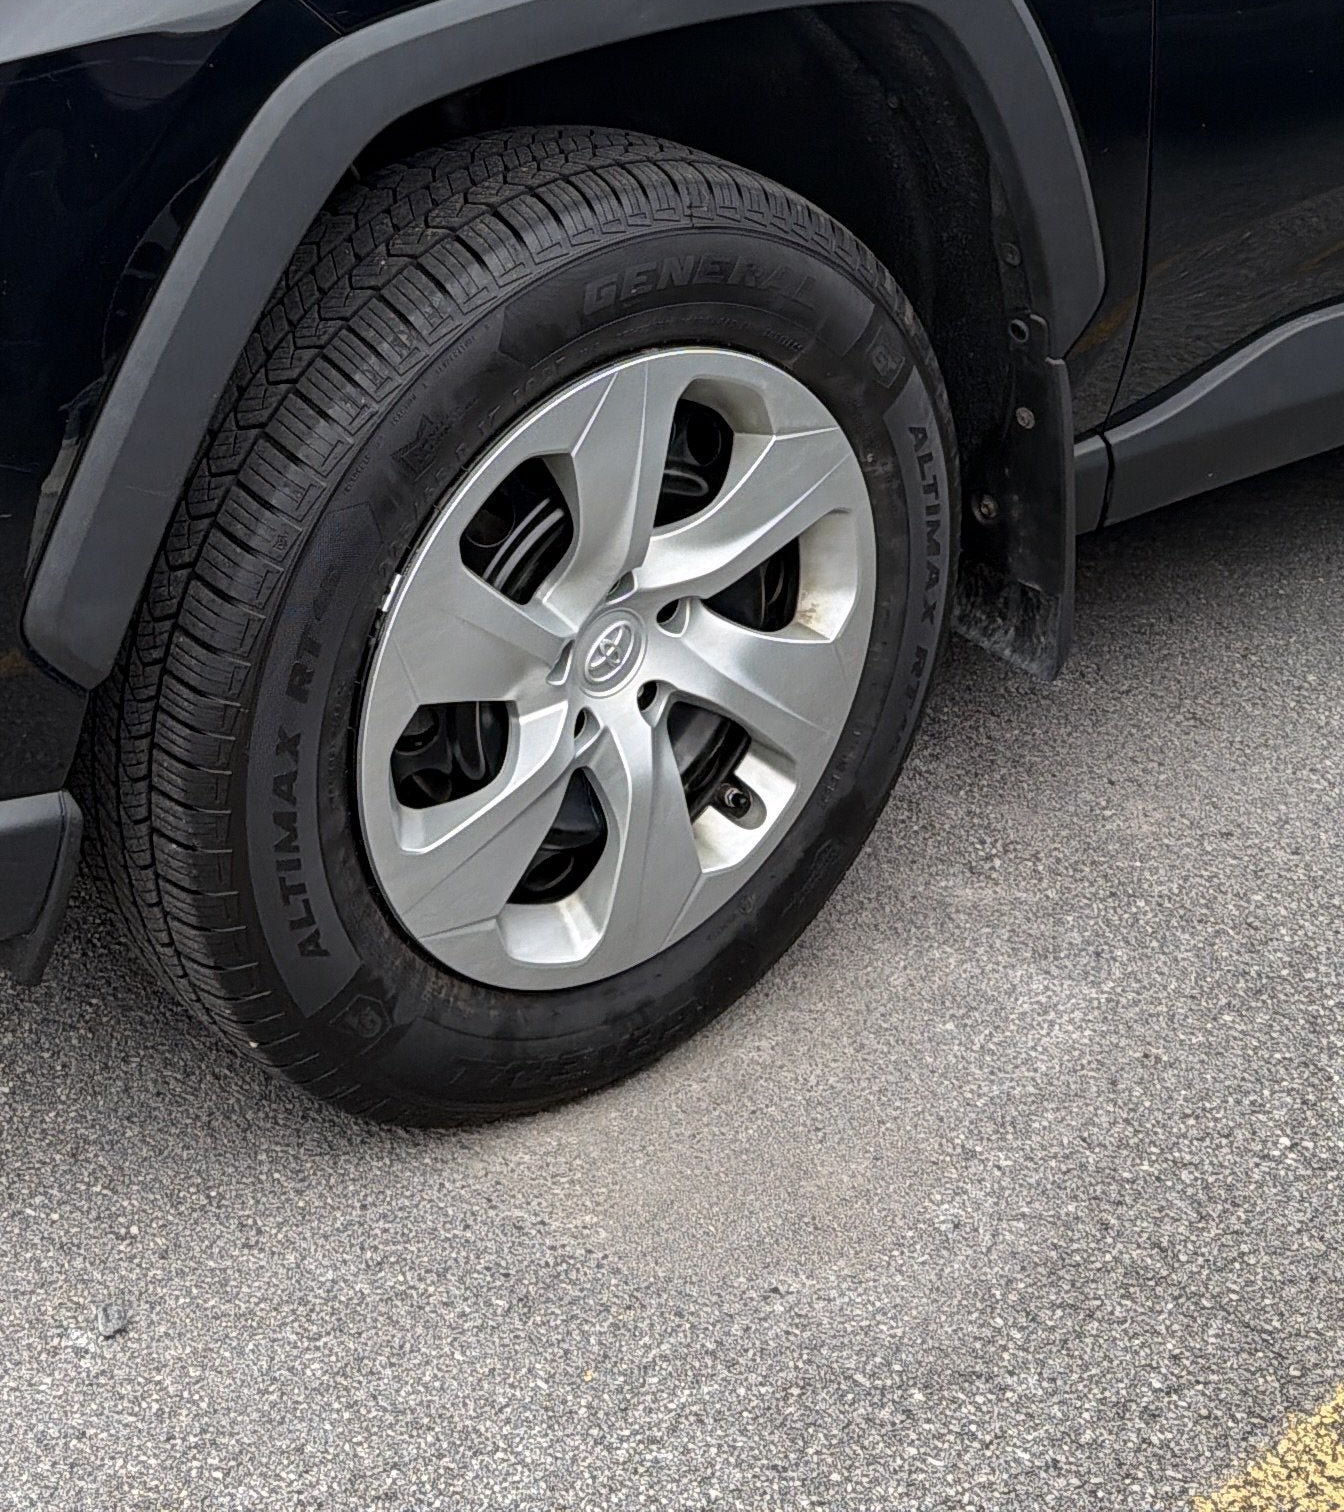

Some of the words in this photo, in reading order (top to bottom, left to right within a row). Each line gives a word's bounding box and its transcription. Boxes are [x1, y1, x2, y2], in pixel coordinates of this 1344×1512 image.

[582, 253, 817, 317] GENERAL
[907, 425, 942, 626] ALTIMAX
[271, 727, 330, 958] ALTIMAX
